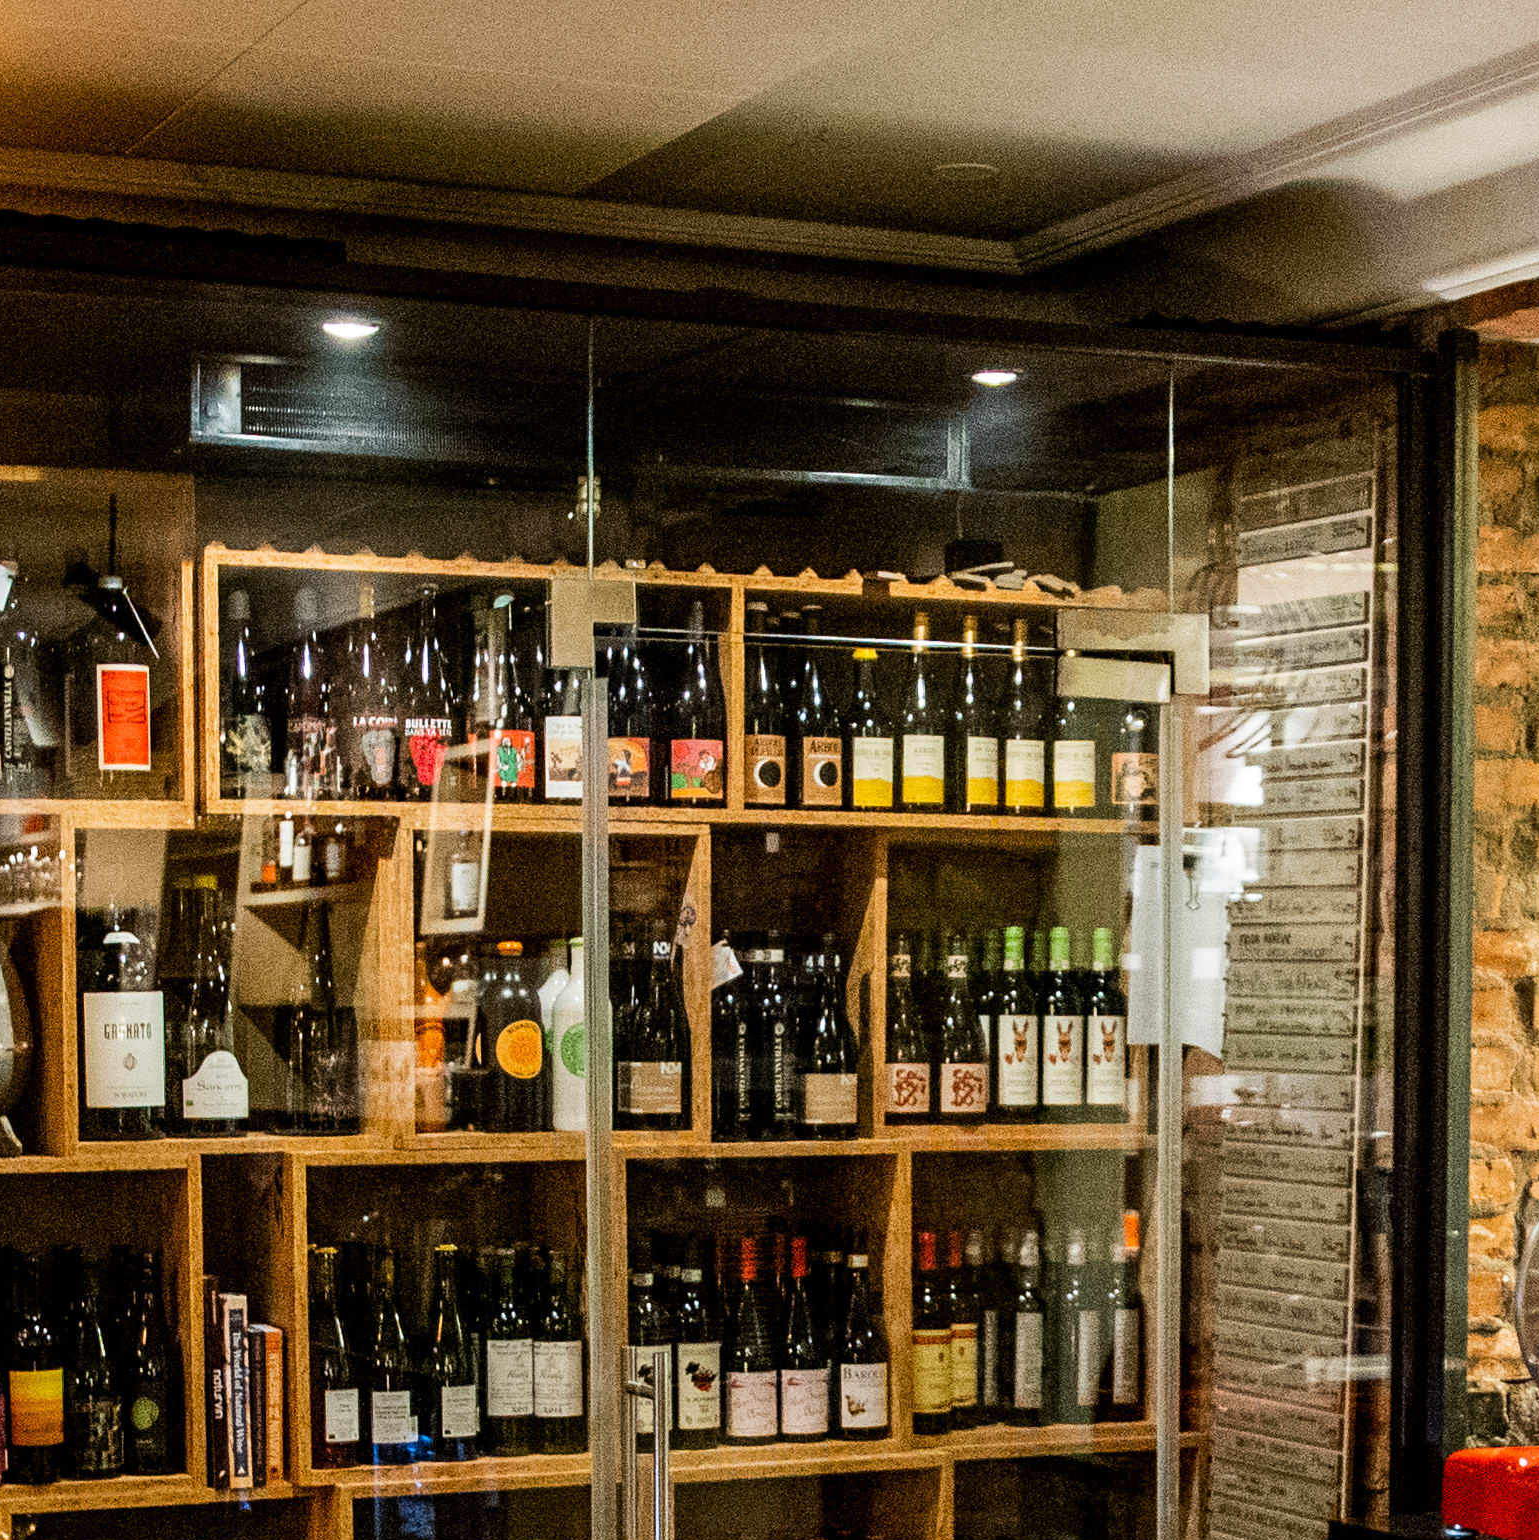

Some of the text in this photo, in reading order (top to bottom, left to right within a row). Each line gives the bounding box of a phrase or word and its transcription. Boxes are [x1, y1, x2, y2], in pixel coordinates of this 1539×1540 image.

[212, 1369, 224, 1419] naturvin
[232, 1331, 245, 1454] The World of Natural Wine
